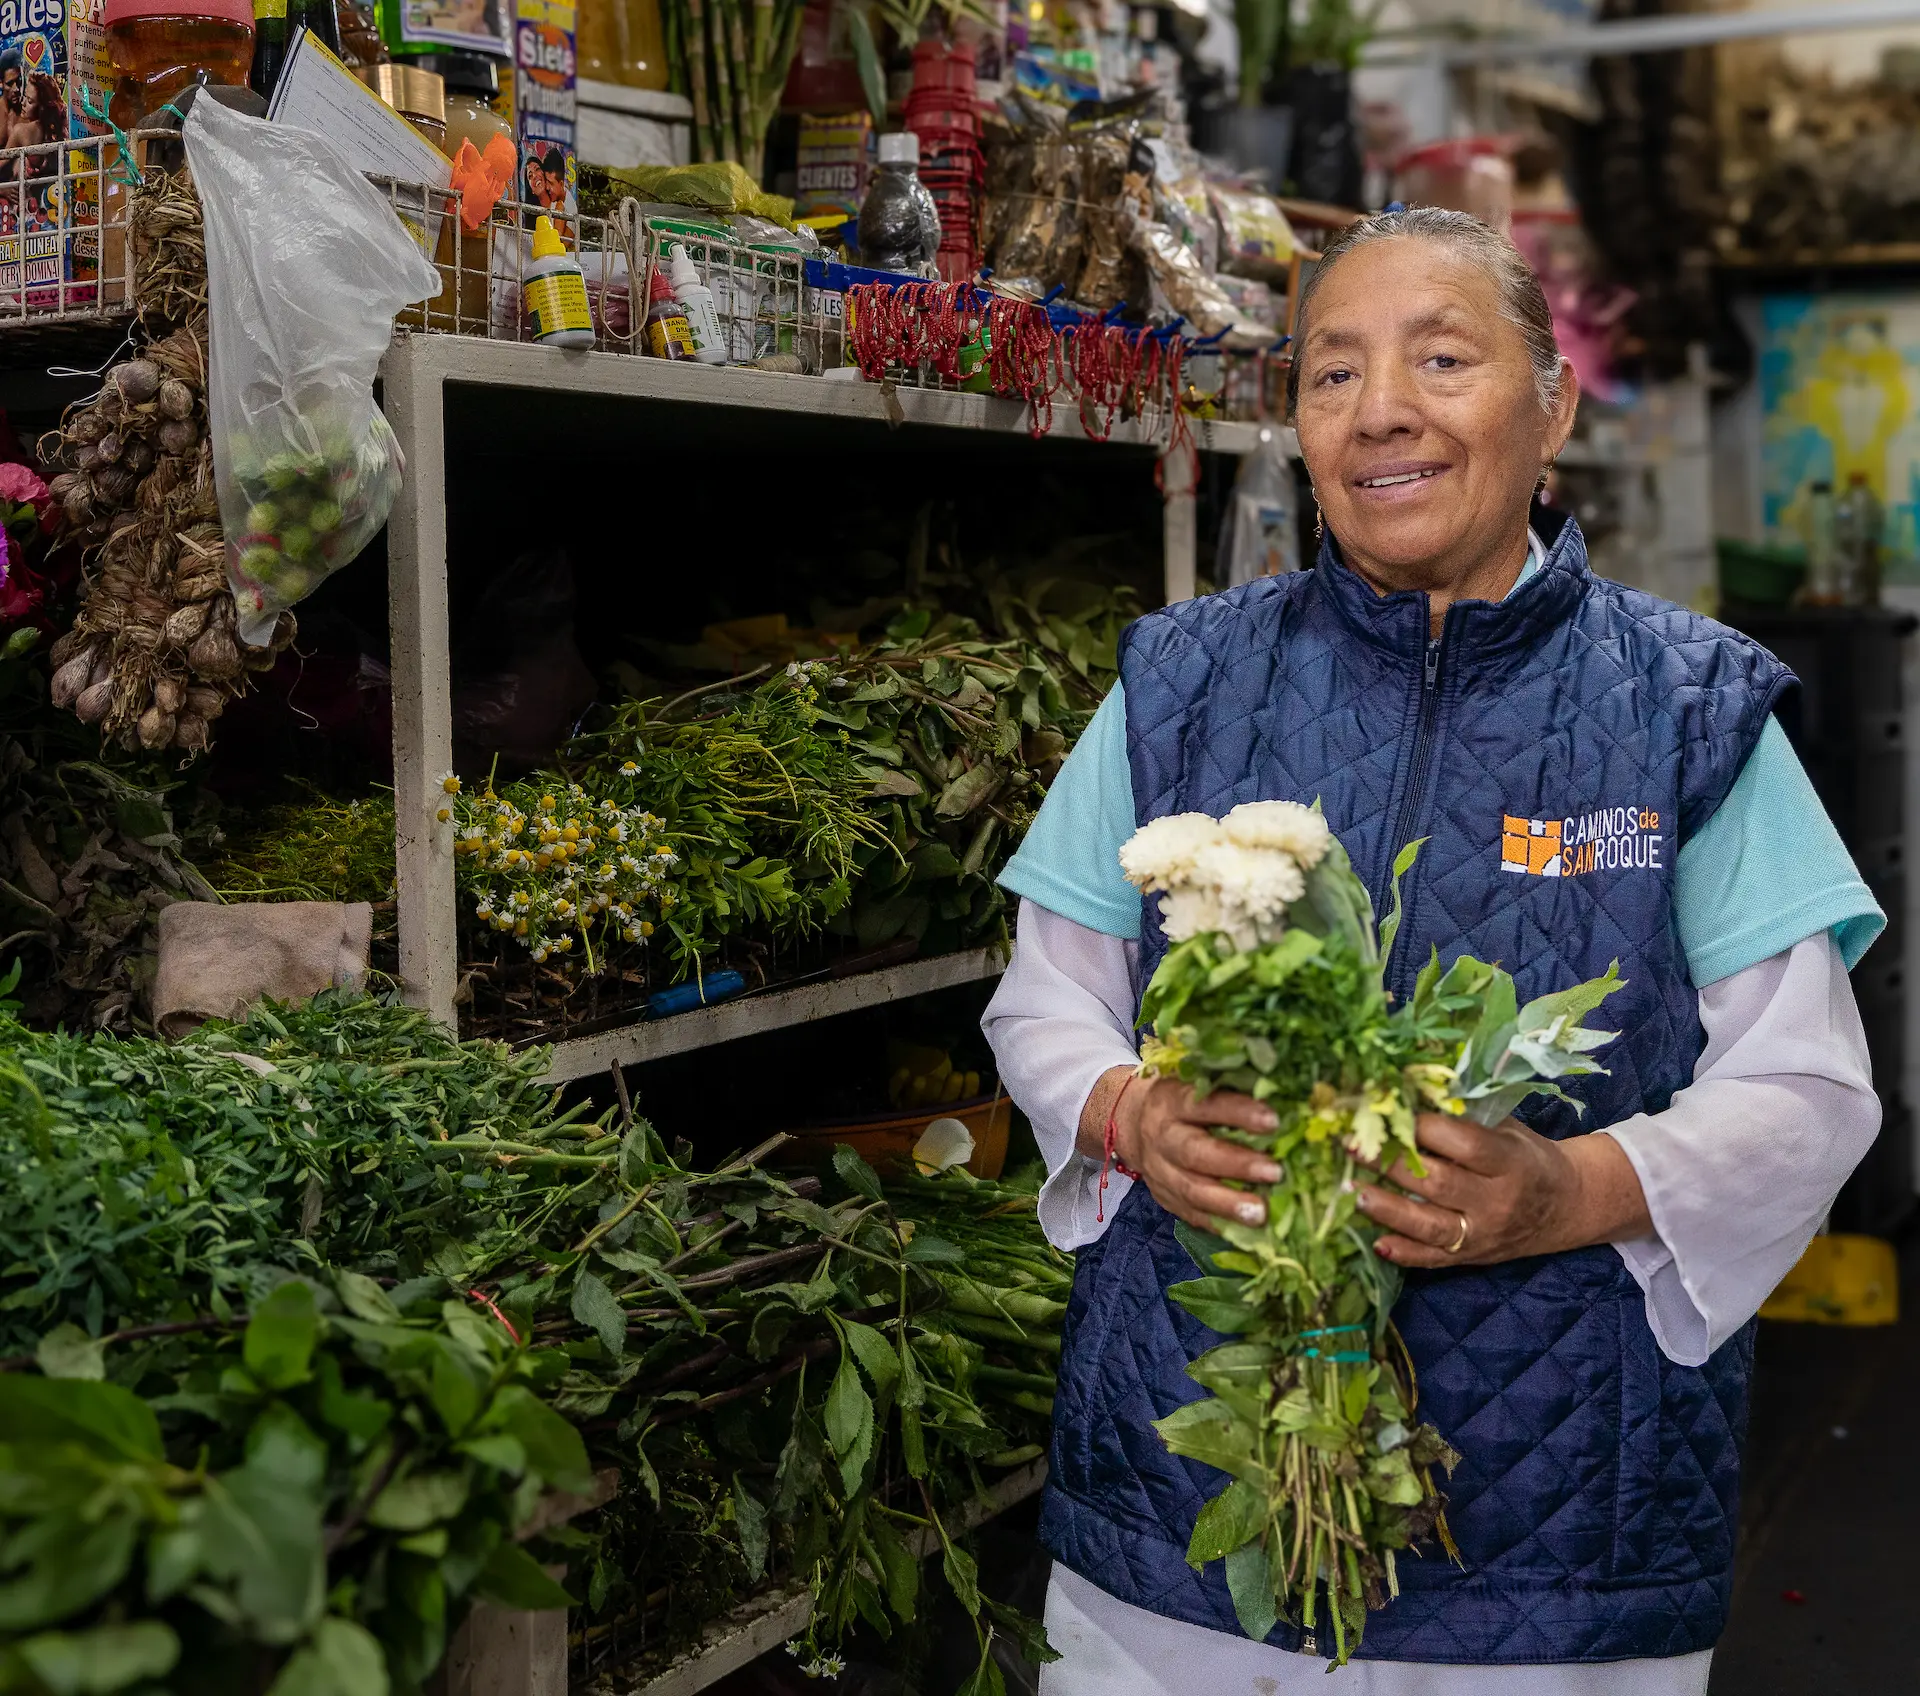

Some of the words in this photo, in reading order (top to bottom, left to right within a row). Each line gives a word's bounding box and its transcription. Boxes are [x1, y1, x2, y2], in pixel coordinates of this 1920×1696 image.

[71, 66, 95, 80] Aroma
[797, 165, 857, 190] CLIENTES
[75, 202, 87, 216] 49
